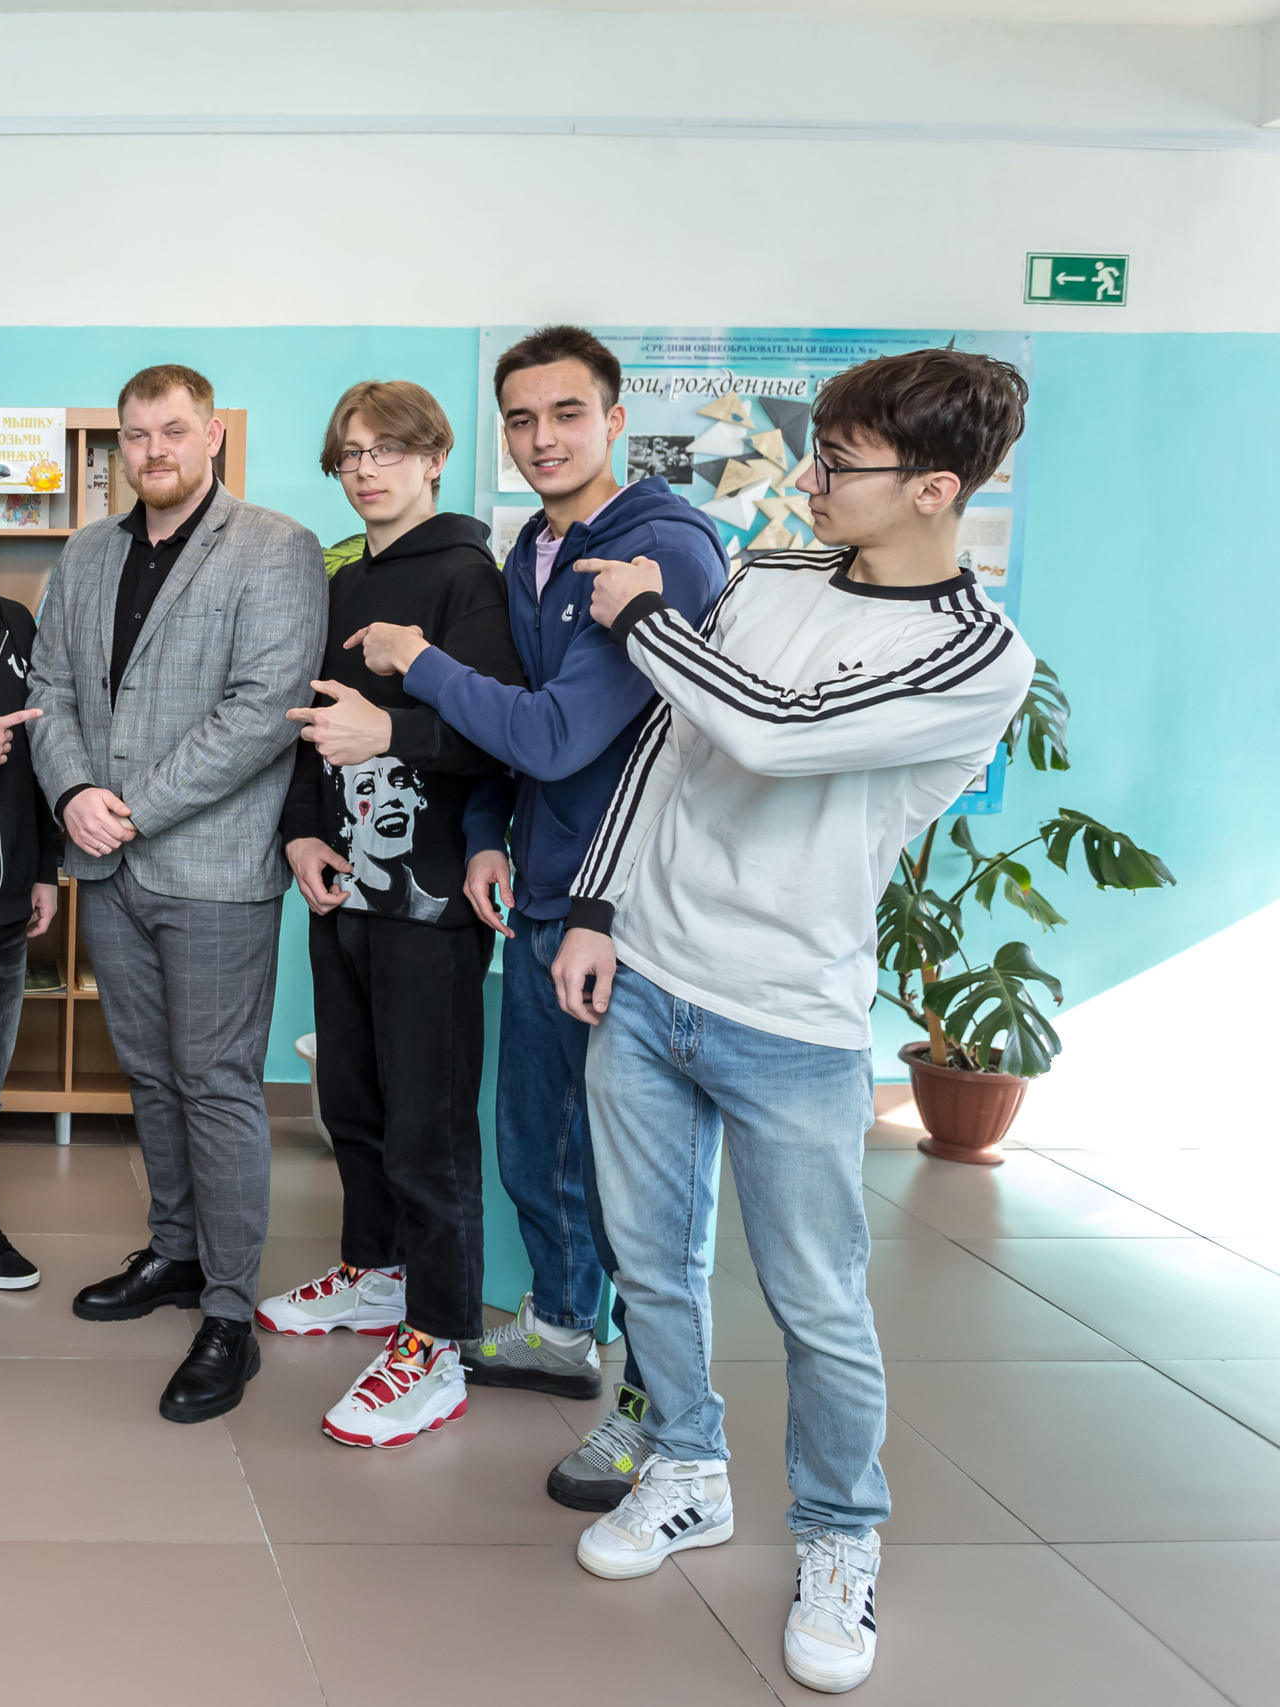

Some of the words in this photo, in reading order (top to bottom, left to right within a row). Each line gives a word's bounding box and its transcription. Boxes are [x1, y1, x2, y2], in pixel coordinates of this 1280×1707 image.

[641, 343, 692, 352] «СРЕДНЯЯ
[693, 344, 817, 354] ОБЩЕОБРАЗОВАТЕЛЬНАЯ
[818, 345, 855, 354] ШКОЛА
[671, 367, 806, 400] рожденные
[2, 417, 55, 429] МЫШКУ
